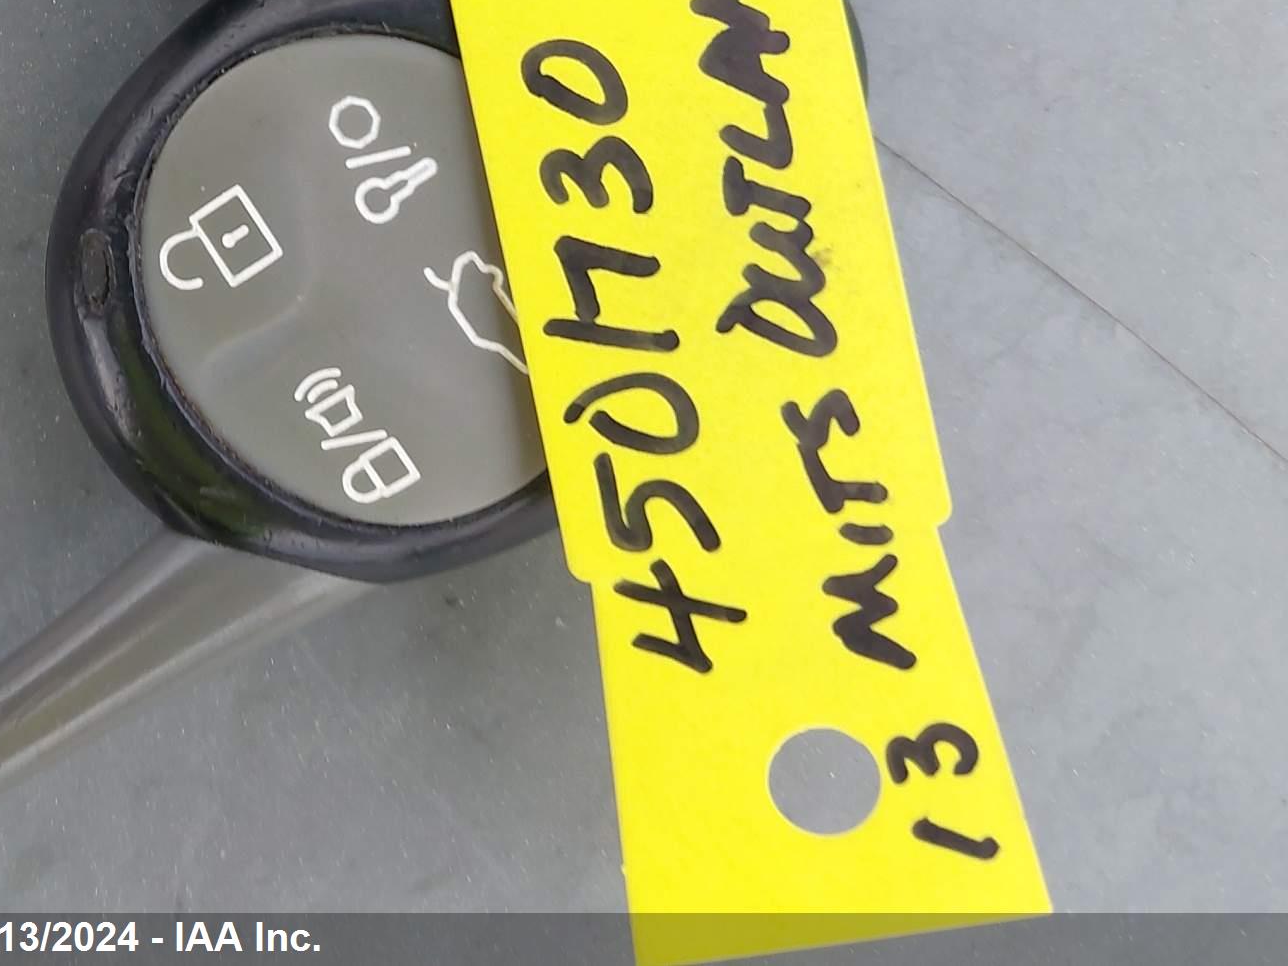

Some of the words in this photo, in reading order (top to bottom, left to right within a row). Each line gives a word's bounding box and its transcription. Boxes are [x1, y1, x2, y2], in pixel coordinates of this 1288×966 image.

[521, 38, 748, 674] 4501730
[782, 388, 917, 670] MITS
[886, 722, 999, 860] 13
